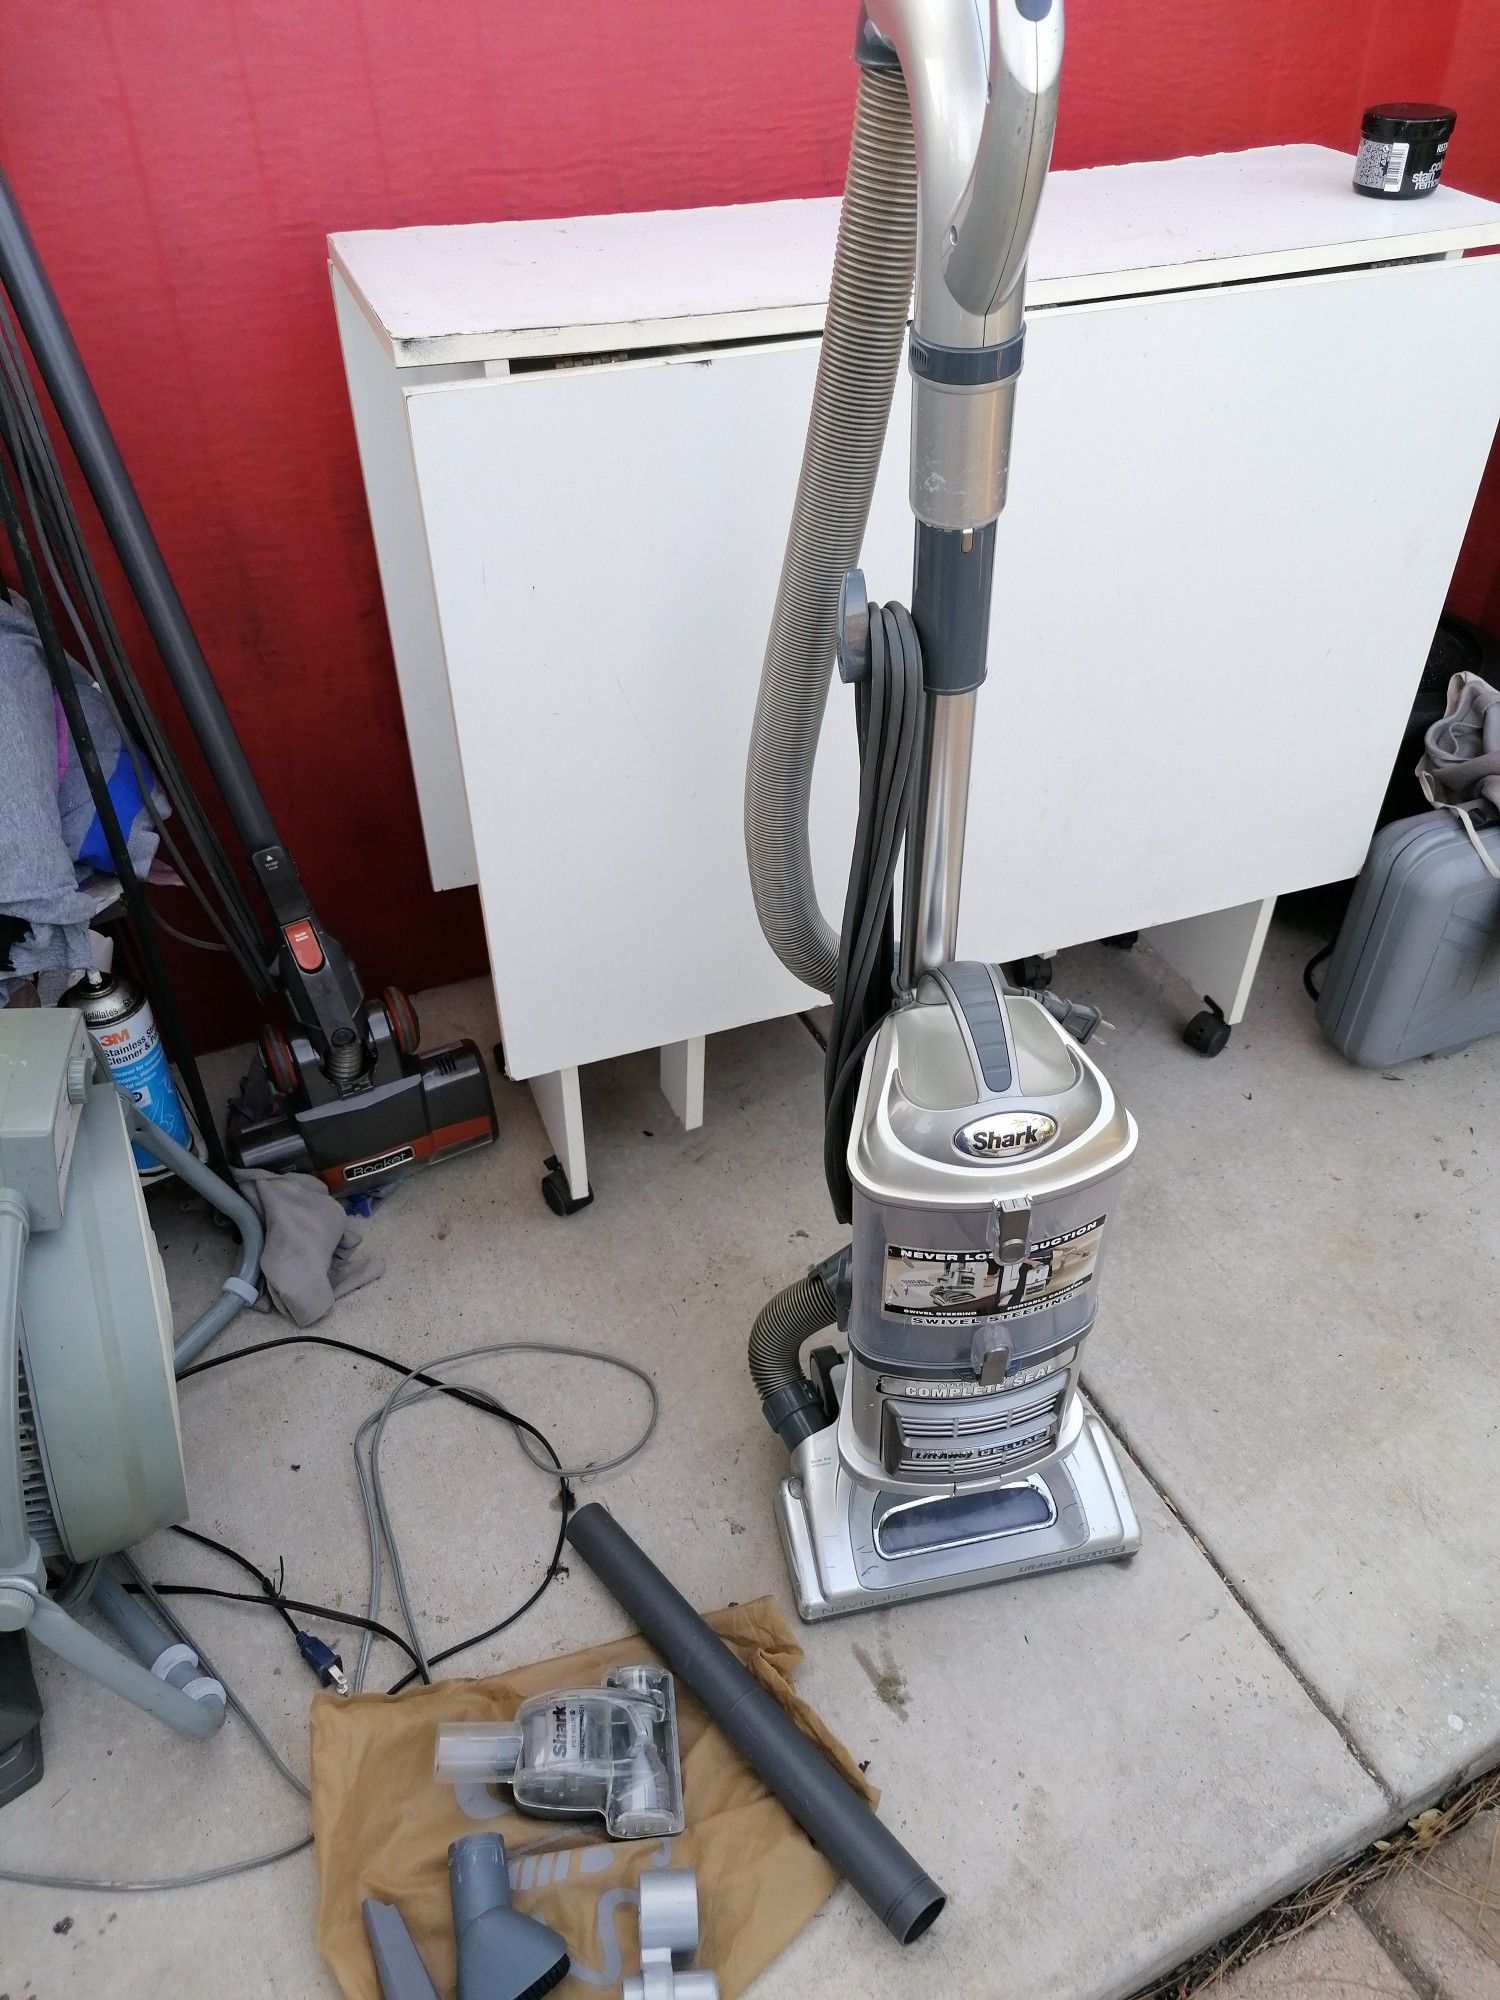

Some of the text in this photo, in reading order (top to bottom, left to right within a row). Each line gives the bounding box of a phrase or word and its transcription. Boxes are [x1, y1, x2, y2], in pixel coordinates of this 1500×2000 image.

[1412, 170, 1435, 183] stain
[100, 1028, 130, 1048] 3M
[144, 1043, 151, 1051] &
[973, 1126, 1038, 1151] Shark
[353, 1153, 407, 1177] Rocket
[900, 1221, 1098, 1261] NEVER LOS SUCTION
[911, 1294, 1074, 1325] SWIVEL STEERING
[1007, 1280, 1084, 1311] PORTABLE CANISTER
[905, 1365, 1055, 1397] COMPLETE SEAL
[553, 1705, 567, 1757] Shark
